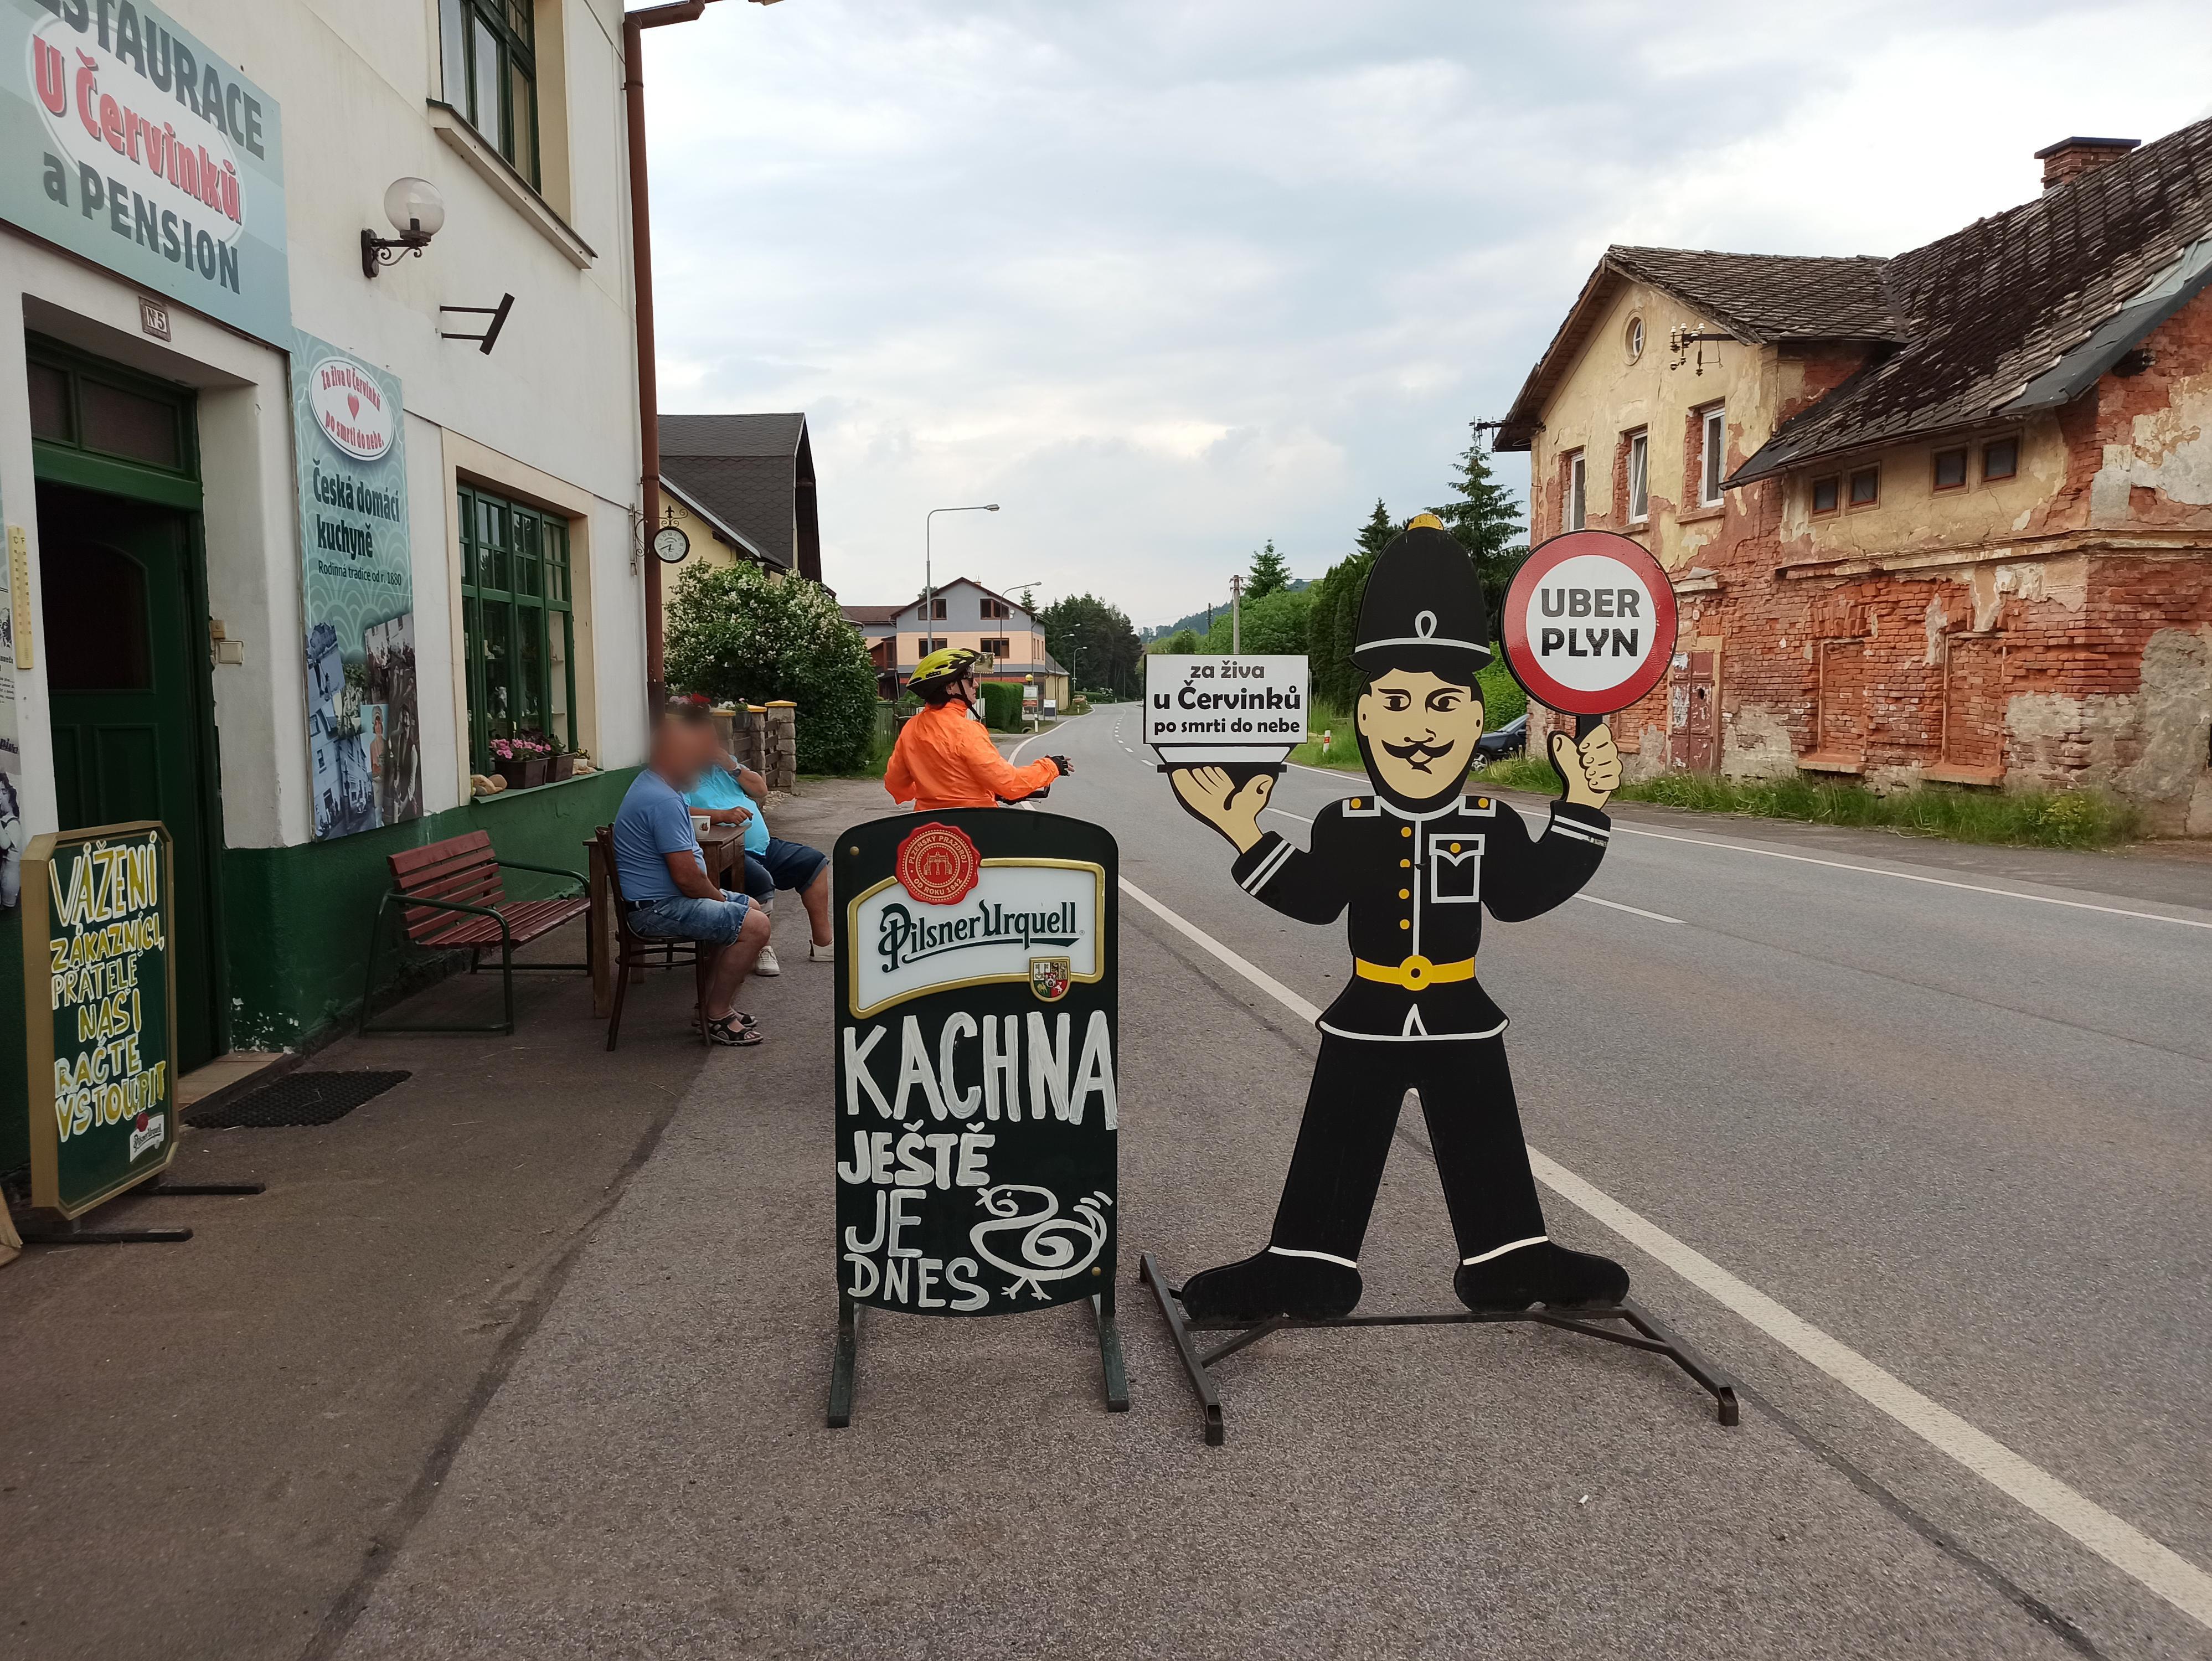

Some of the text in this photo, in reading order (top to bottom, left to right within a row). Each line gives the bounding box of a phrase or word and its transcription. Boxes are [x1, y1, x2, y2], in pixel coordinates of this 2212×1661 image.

[33, 34, 243, 226] U Červinků
[43, 151, 240, 295] a PENSION
[321, 370, 331, 390] Za
[346, 368, 352, 388] U
[352, 367, 381, 412] Červinků
[325, 410, 335, 433] po
[336, 421, 356, 447] smrti
[357, 429, 365, 450] do
[313, 457, 400, 523] Česká domácí
[316, 513, 373, 561] kuchyně
[318, 560, 347, 577] Rodinná
[348, 566, 371, 582] tradice
[372, 570, 380, 582] od
[1541, 588, 1641, 618] UBER
[1541, 627, 1639, 657] PLYN
[1153, 679, 1301, 710] u Červinků
[1190, 660, 1265, 679] za živa
[1154, 718, 1300, 736] po smrti do nebe
[909, 835, 967, 864] PLZEŇSKÝ PRAZDROJ
[49, 830, 157, 927] VÁŽENÍ
[914, 878, 963, 895] OD ROKU 1842
[878, 899, 1076, 973] Pilsner Urquell
[55, 1033, 142, 1098] RAČTE
[843, 1009, 1118, 1131] KACHNA
[55, 1060, 166, 1143] VSTOUPIT
[837, 1119, 996, 1190] JEŠTĚ
[845, 1189, 927, 1258] JE
[843, 1252, 989, 1311] DNES
